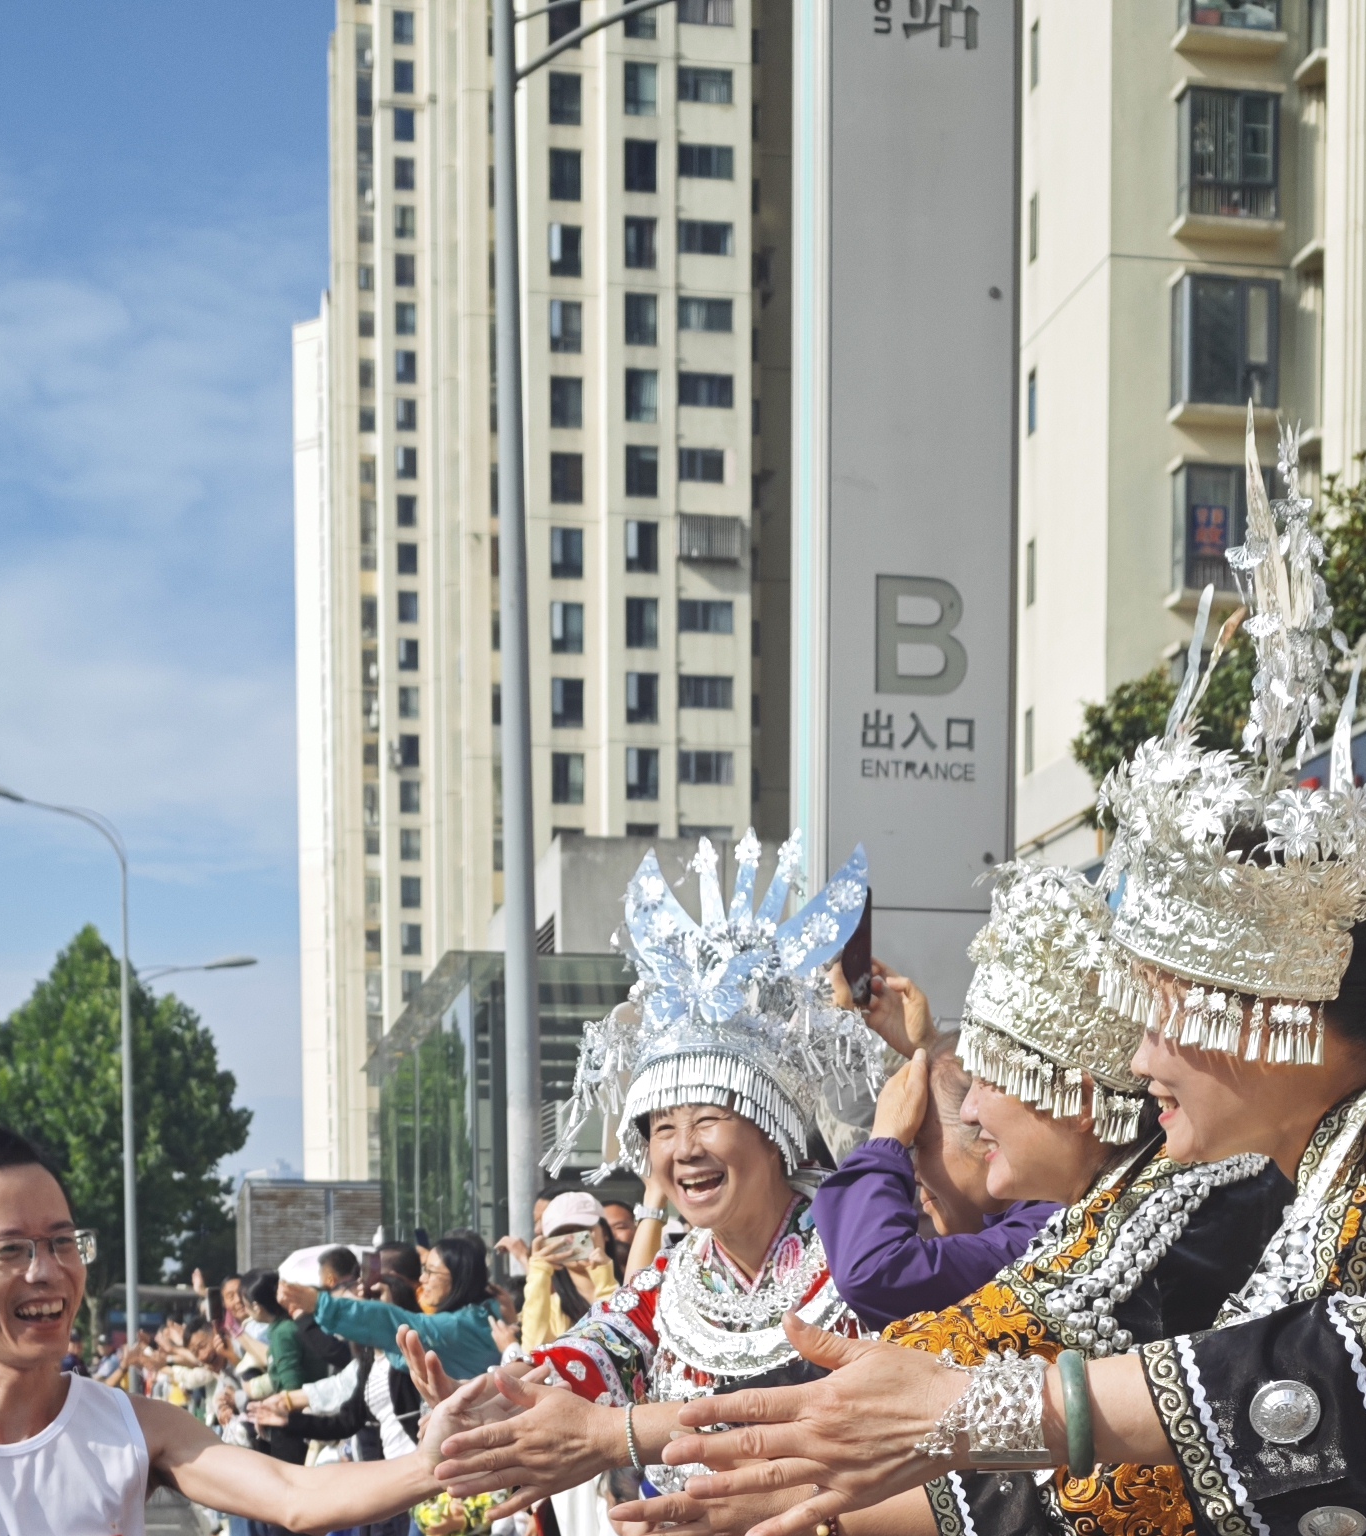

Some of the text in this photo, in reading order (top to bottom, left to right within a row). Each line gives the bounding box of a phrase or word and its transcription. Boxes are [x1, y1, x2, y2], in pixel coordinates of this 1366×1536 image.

[875, 573, 969, 697] B
[861, 708, 976, 751] 出入口
[861, 758, 976, 782] ENTRANCE
